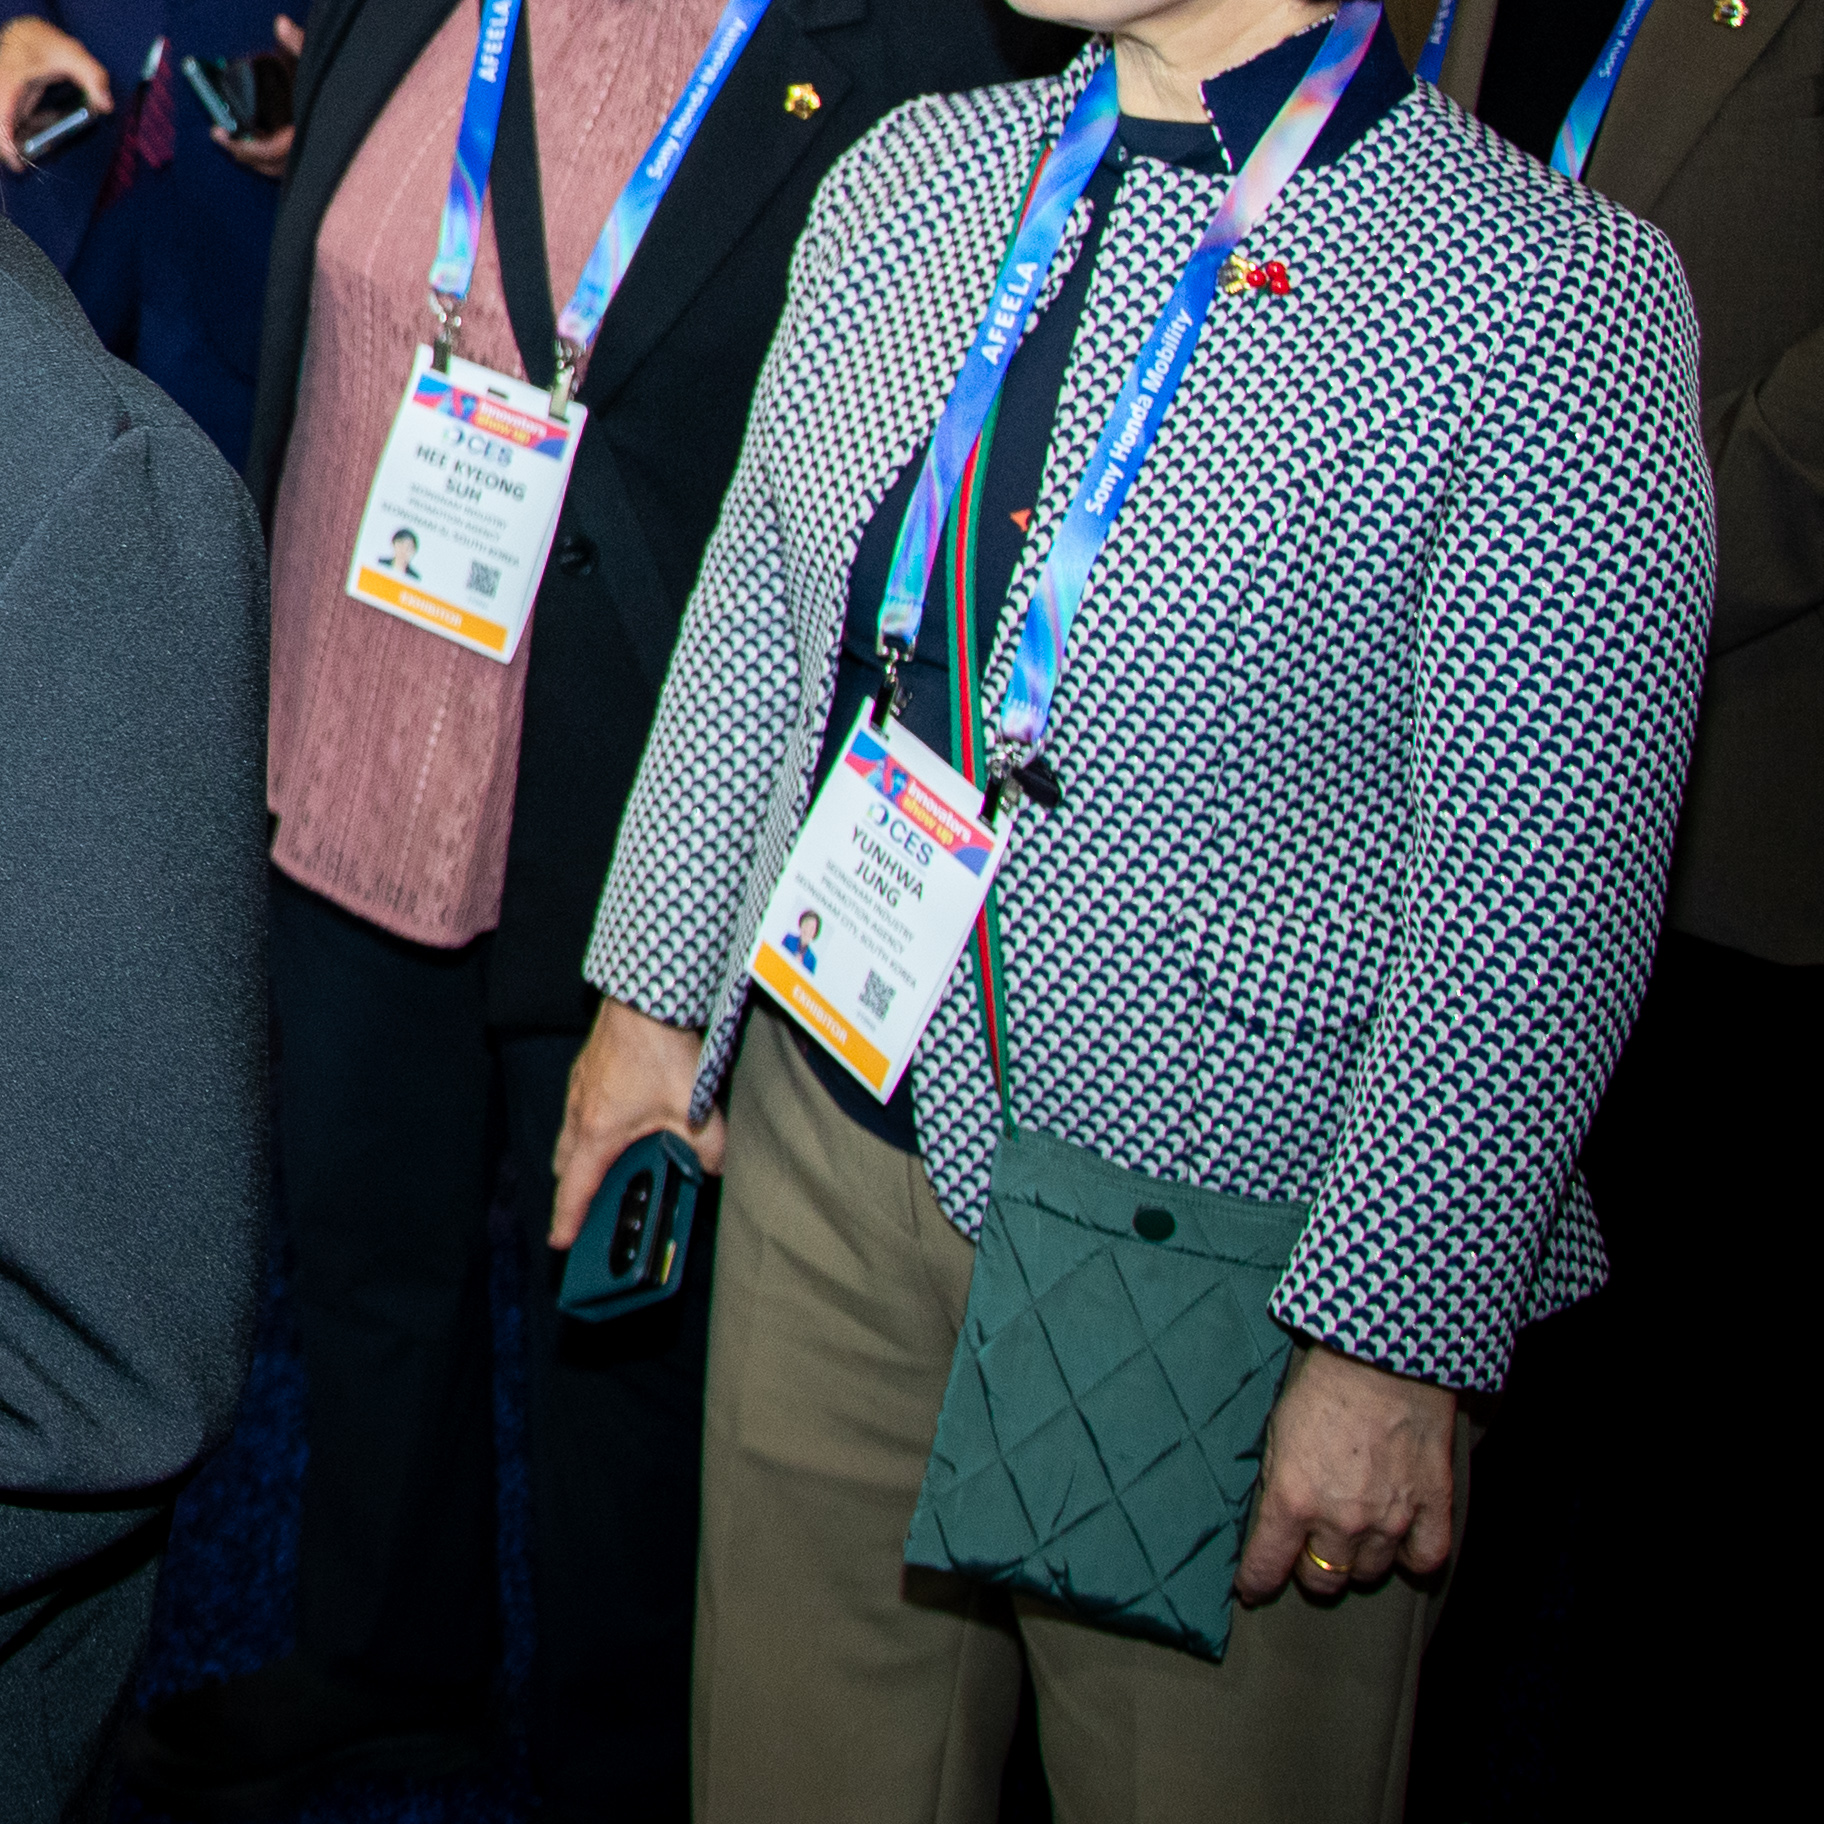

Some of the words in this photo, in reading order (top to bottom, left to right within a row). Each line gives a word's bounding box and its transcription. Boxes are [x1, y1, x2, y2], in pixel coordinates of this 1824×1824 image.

[645, 135, 680, 180] Sony
[670, 83, 709, 139] Honda
[700, 16, 748, 85] Mobility
[980, 261, 1039, 366] AFEELA
[1083, 461, 1125, 517] Sony
[1108, 392, 1155, 463] Honda
[1140, 307, 1194, 394] Mobility
[453, 458, 528, 502] KYEONG
[467, 433, 515, 467] CES
[902, 797, 938, 836] show
[935, 822, 955, 847] up
[907, 780, 973, 843] innovators
[851, 824, 925, 903] YUNHWA
[888, 819, 934, 867] CES
[854, 860, 900, 908] JUNG
[792, 983, 849, 1045] EXHIBITOR
